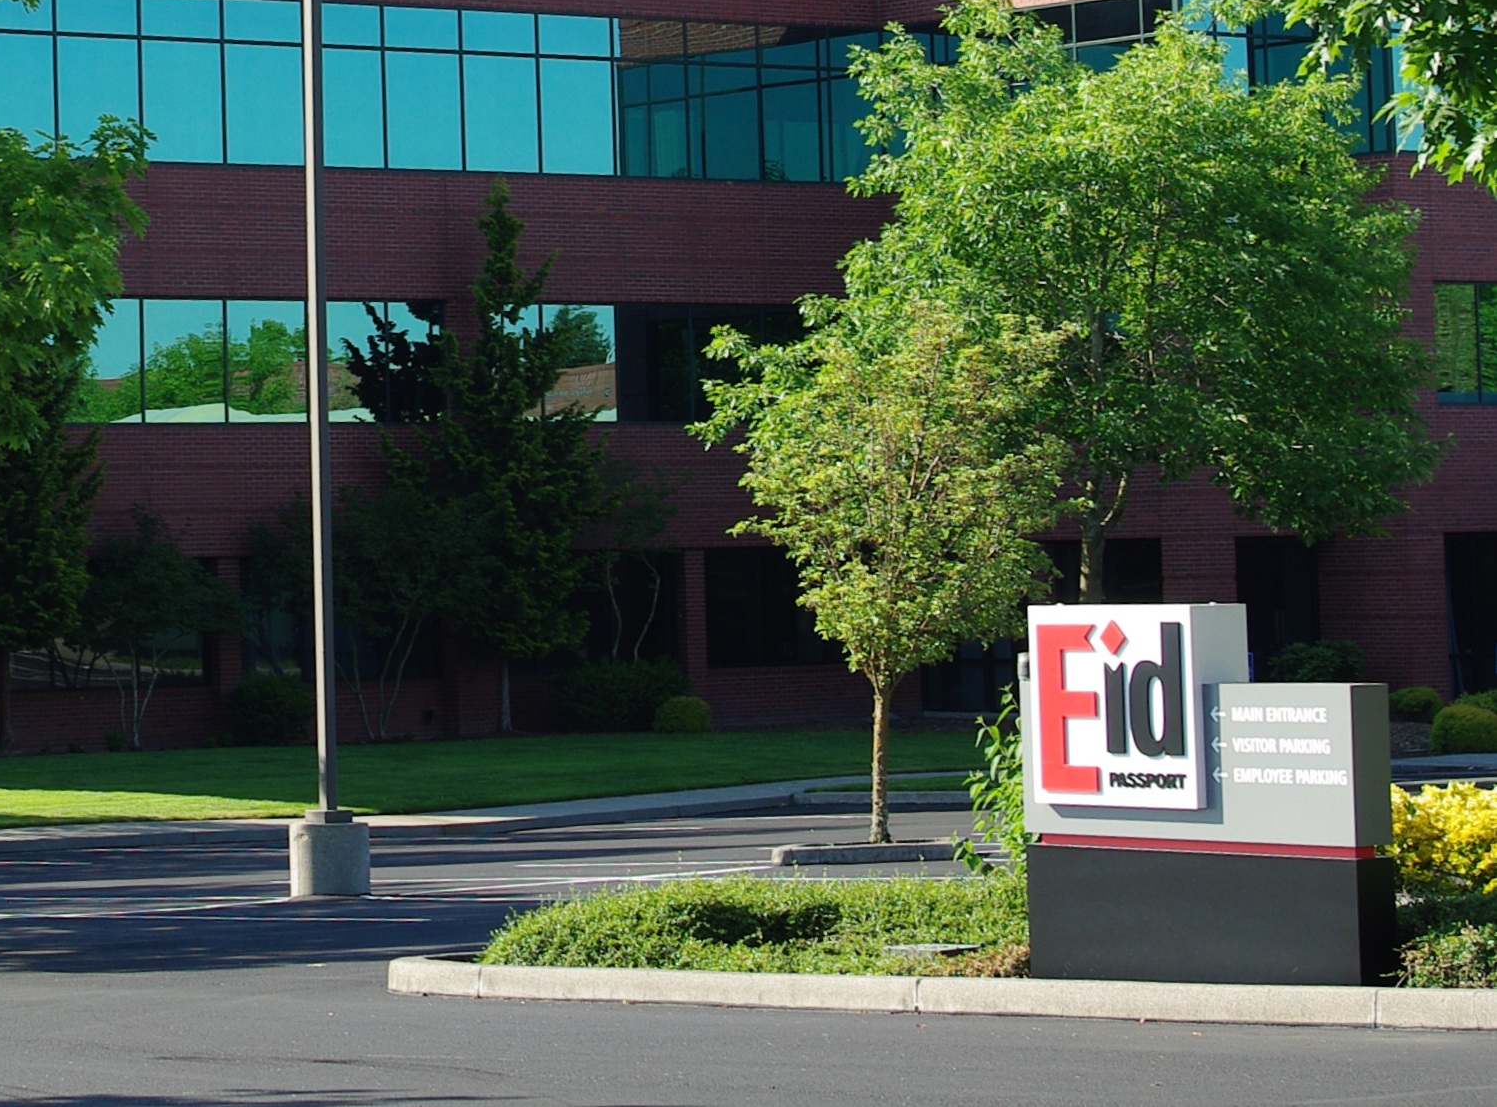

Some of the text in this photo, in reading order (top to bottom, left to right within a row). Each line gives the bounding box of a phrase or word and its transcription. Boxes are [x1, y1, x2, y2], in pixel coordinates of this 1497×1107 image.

[1036, 619, 1186, 792] Eid
[1231, 706, 1327, 723] MAIN ENTRANCE
[1231, 737, 1331, 754] VISITOR PARKING
[1109, 772, 1187, 789] PASSPORT
[1233, 767, 1348, 786] EMPLOYEE PARKING
